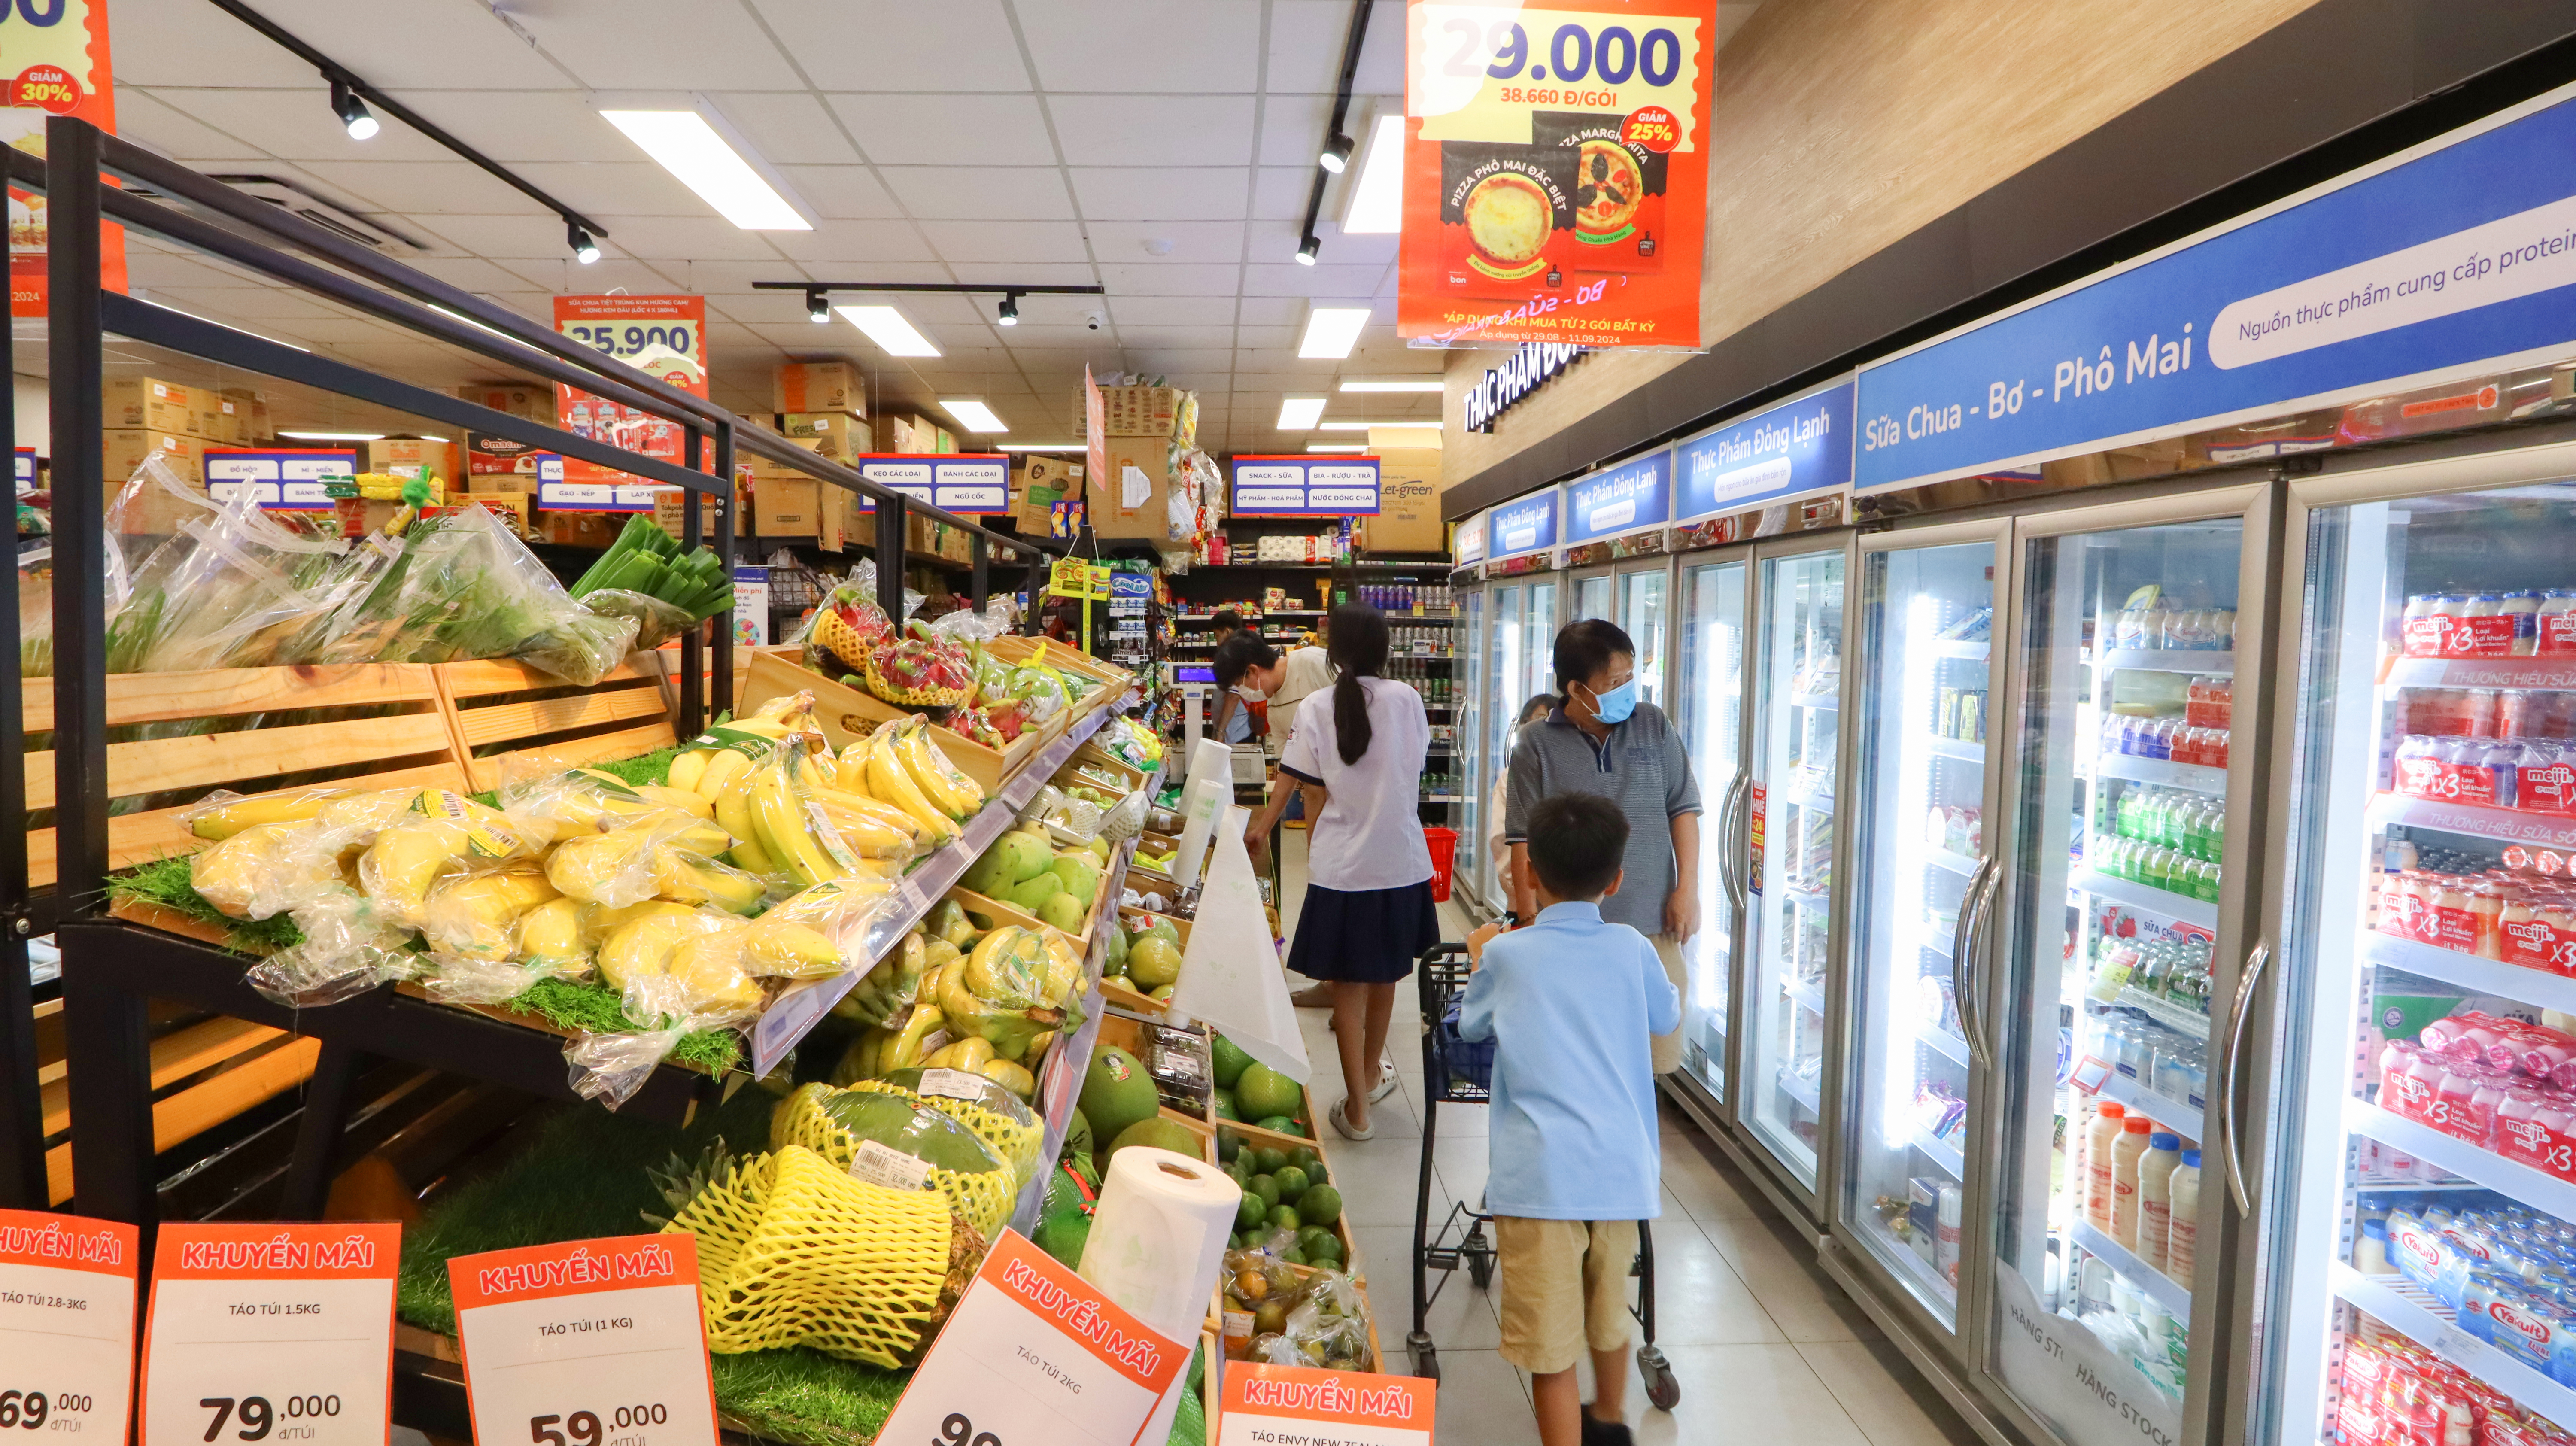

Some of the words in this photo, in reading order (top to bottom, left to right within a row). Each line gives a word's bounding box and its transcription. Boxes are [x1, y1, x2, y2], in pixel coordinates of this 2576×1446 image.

[1443, 18, 1680, 86] 29.000
[29, 67, 62, 82] GIẢM
[21, 83, 73, 102] 30%
[1500, 88, 1559, 104] 38.660
[1563, 88, 1617, 107] Đ/GÓI
[1638, 110, 1666, 122] GIẢM
[1629, 123, 1673, 141] 25%
[1451, 176, 1476, 207] PIZZA
[1474, 159, 1500, 178] PHÔ
[1503, 160, 1526, 172] MAI
[1528, 165, 1552, 186] ĐẶC
[1549, 185, 1567, 210] BIỆT
[1450, 275, 1467, 284] bon
[12, 292, 40, 302] .2024
[2239, 310, 2290, 341] Nguồn
[2297, 298, 2333, 325] thực
[2338, 282, 2390, 318] phẩm
[2397, 269, 2446, 296] cung
[2453, 252, 2491, 281] cấp
[1506, 317, 1526, 326] KHI
[1529, 318, 1557, 328] MUA
[1561, 316, 1578, 328] TỪ
[1579, 320, 1586, 329] 2
[1589, 318, 1610, 330] GÓI
[1613, 319, 1637, 331] BẤT
[1640, 321, 1655, 332] KỲ
[1480, 328, 1493, 339] Áp
[1495, 330, 1519, 340] dụng
[1520, 331, 1531, 339] từ
[1569, 334, 1620, 343] 11.09.2024
[1865, 415, 1900, 451] Sữa
[1907, 403, 1962, 440] Chua
[1988, 379, 2024, 420] Bơ
[2054, 345, 2115, 403] Phô
[2126, 322, 2192, 384] Mai
[1464, 370, 1496, 433] THỰC
[793, 425, 819, 434] FRES
[1691, 449, 1716, 477] Thực
[1719, 432, 1750, 466] Phẩm
[1754, 423, 1789, 455] Đông
[1794, 407, 1829, 448] Lạnh
[1576, 491, 1591, 511] Thực
[1593, 479, 1612, 504] Phẩm
[1614, 474, 1634, 497] Đông
[1637, 465, 1656, 494] Lạnh
[1522, 506, 1535, 525] Đông
[1536, 502, 1549, 524] Lạnh
[1112, 579, 1134, 590] Cool
[2412, 617, 2449, 634] meiji
[2454, 671, 2511, 685] THƯƠNG
[2527, 767, 2570, 786] meiji
[2430, 812, 2484, 832] THƯƠNG
[2521, 824, 2552, 841] SỮA
[2144, 920, 2160, 935] SỮA
[2162, 927, 2184, 942] CHUA
[2508, 923, 2549, 943] meiji
[2506, 1118, 2545, 1143] meiji
[889, 1173, 908, 1186] 32.000
[0, 1221, 73, 1258] HUYẾN
[78, 1231, 122, 1265] MÃI
[181, 1232, 309, 1270] KHUYẾN
[314, 1234, 374, 1270] MÃI
[2408, 1236, 2434, 1262] Yakult
[480, 1247, 611, 1295] KHUYẾN
[616, 1243, 674, 1279] MÃI
[1, 1291, 24, 1305] TÁO
[27, 1293, 45, 1306] TÚI
[47, 1296, 87, 1311] 2.8-3KG
[229, 1301, 256, 1316] TÁO
[260, 1300, 281, 1315] TÚI
[285, 1303, 321, 1315] 1.5KG
[538, 1322, 566, 1337] TÁO
[569, 1318, 592, 1333] TÚI
[595, 1319, 608, 1333] (1
[611, 1317, 633, 1330] KG)
[1003, 1258, 1110, 1344] KHUYẾN
[1105, 1328, 1161, 1377] MÃI
[2011, 1304, 2043, 1344] HÀNG
[2500, 1308, 2542, 1339] Yakult
[1017, 1345, 1040, 1366] TÁO
[1041, 1358, 1060, 1379] TÚI
[1059, 1374, 1082, 1395] 2KG
[1244, 1377, 1355, 1413] KHUYẾN
[1360, 1386, 1413, 1419] MÃI
[2076, 1363, 2117, 1409] HÀNG
[2121, 1402, 2172, 1446] STOCK
[50, 1417, 82, 1433] đ/TÚI
[200, 1396, 274, 1443] 79
[530, 1410, 604, 1446] 59
[279, 1426, 316, 1440] đ/TÚI
[1251, 1430, 1275, 1443] TÁO
[1278, 1432, 1309, 1446] ENVY
